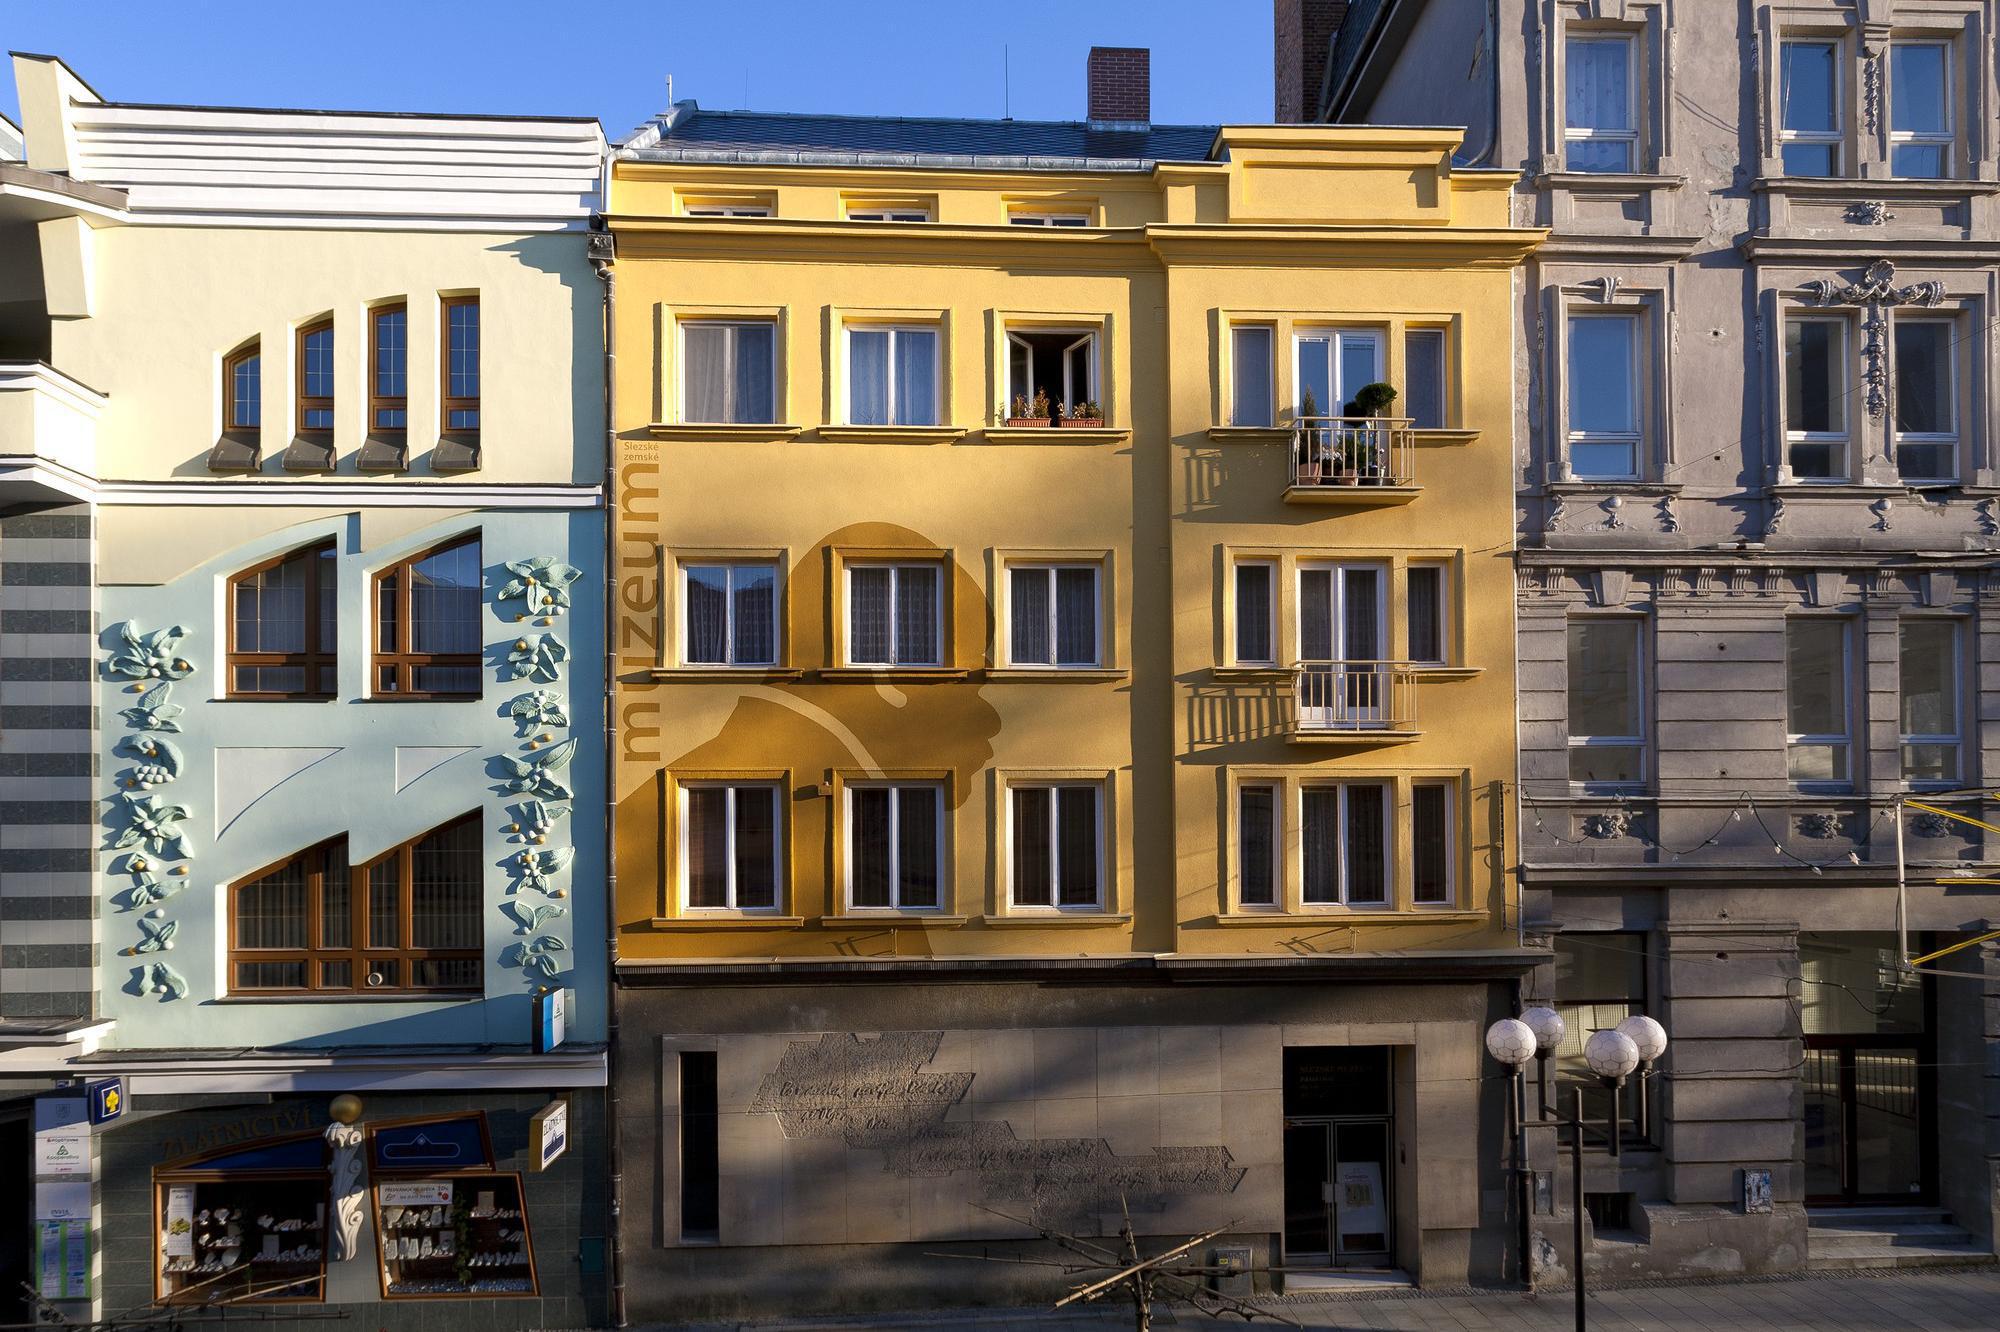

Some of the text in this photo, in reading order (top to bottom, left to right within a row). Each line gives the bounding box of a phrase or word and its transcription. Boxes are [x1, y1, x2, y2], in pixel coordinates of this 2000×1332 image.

[623, 441, 659, 451] Slezské
[623, 452, 659, 461] zemské
[621, 462, 661, 762] muzeum
[162, 1104, 313, 1160] ZLATNICTVÍ
